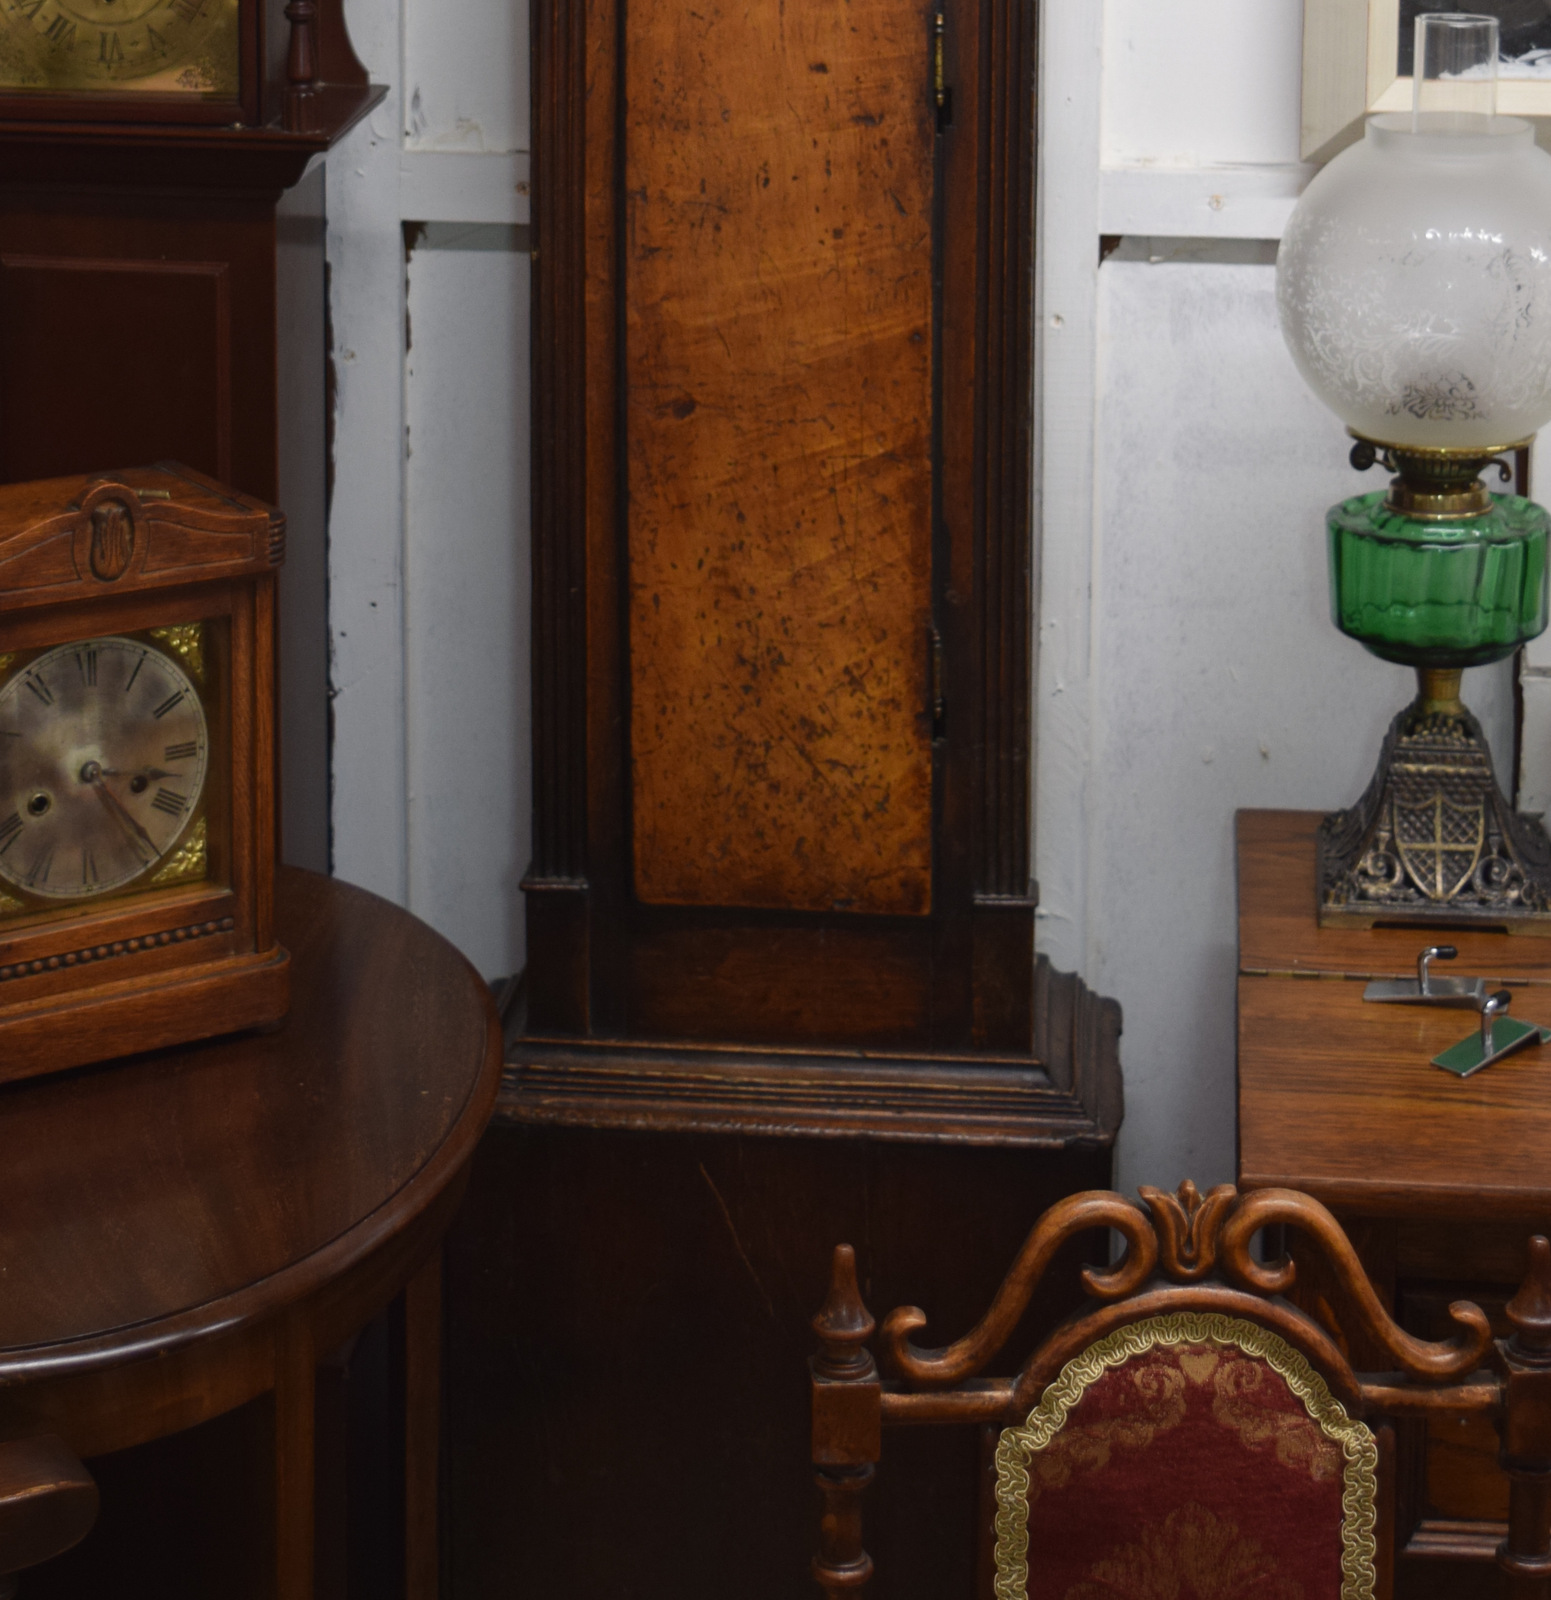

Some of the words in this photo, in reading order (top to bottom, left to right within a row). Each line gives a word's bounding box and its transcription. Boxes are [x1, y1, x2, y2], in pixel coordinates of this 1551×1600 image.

[153, 688, 185, 720] II
[164, 740, 198, 762] III
[151, 787, 188, 818] IIII
